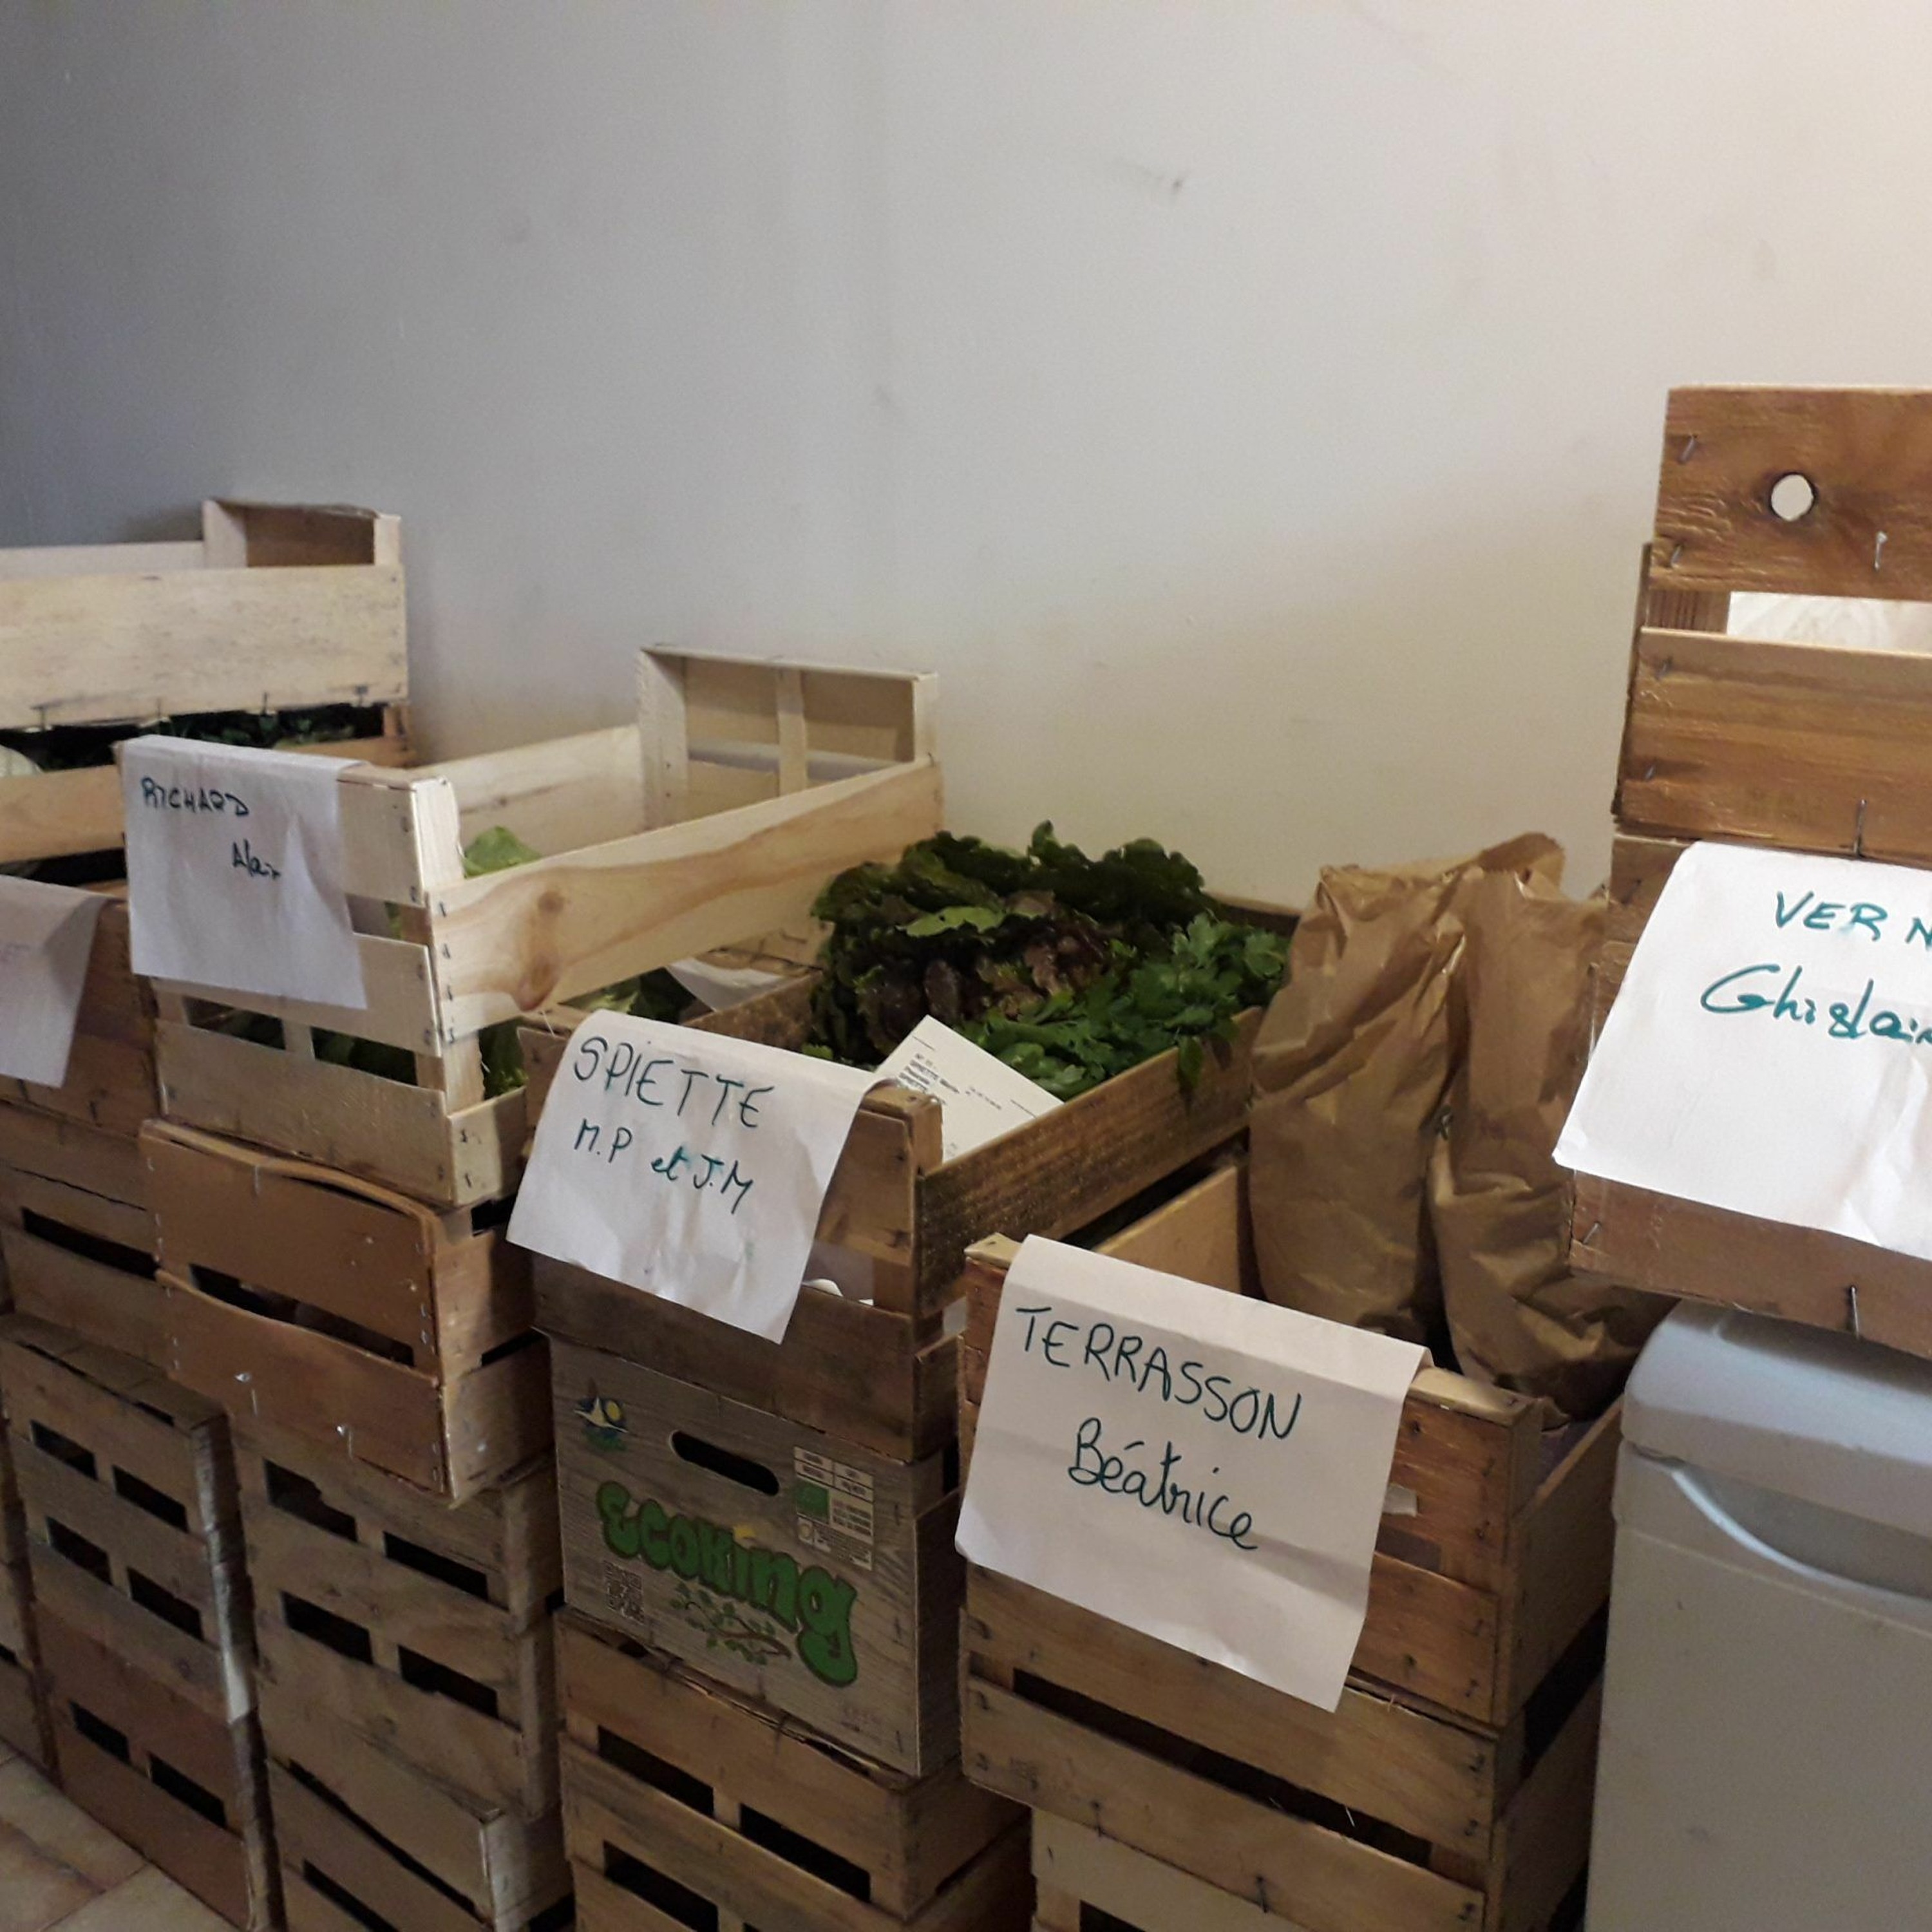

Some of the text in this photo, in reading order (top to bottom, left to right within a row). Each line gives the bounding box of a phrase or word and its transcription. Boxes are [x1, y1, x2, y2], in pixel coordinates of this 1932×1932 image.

[141, 777, 250, 816] RICHARD
[574, 1036, 775, 1128] SPIETTE
[1016, 1306, 1302, 1440] TERRASSON
[1068, 1417, 1258, 1549] Béatrice
